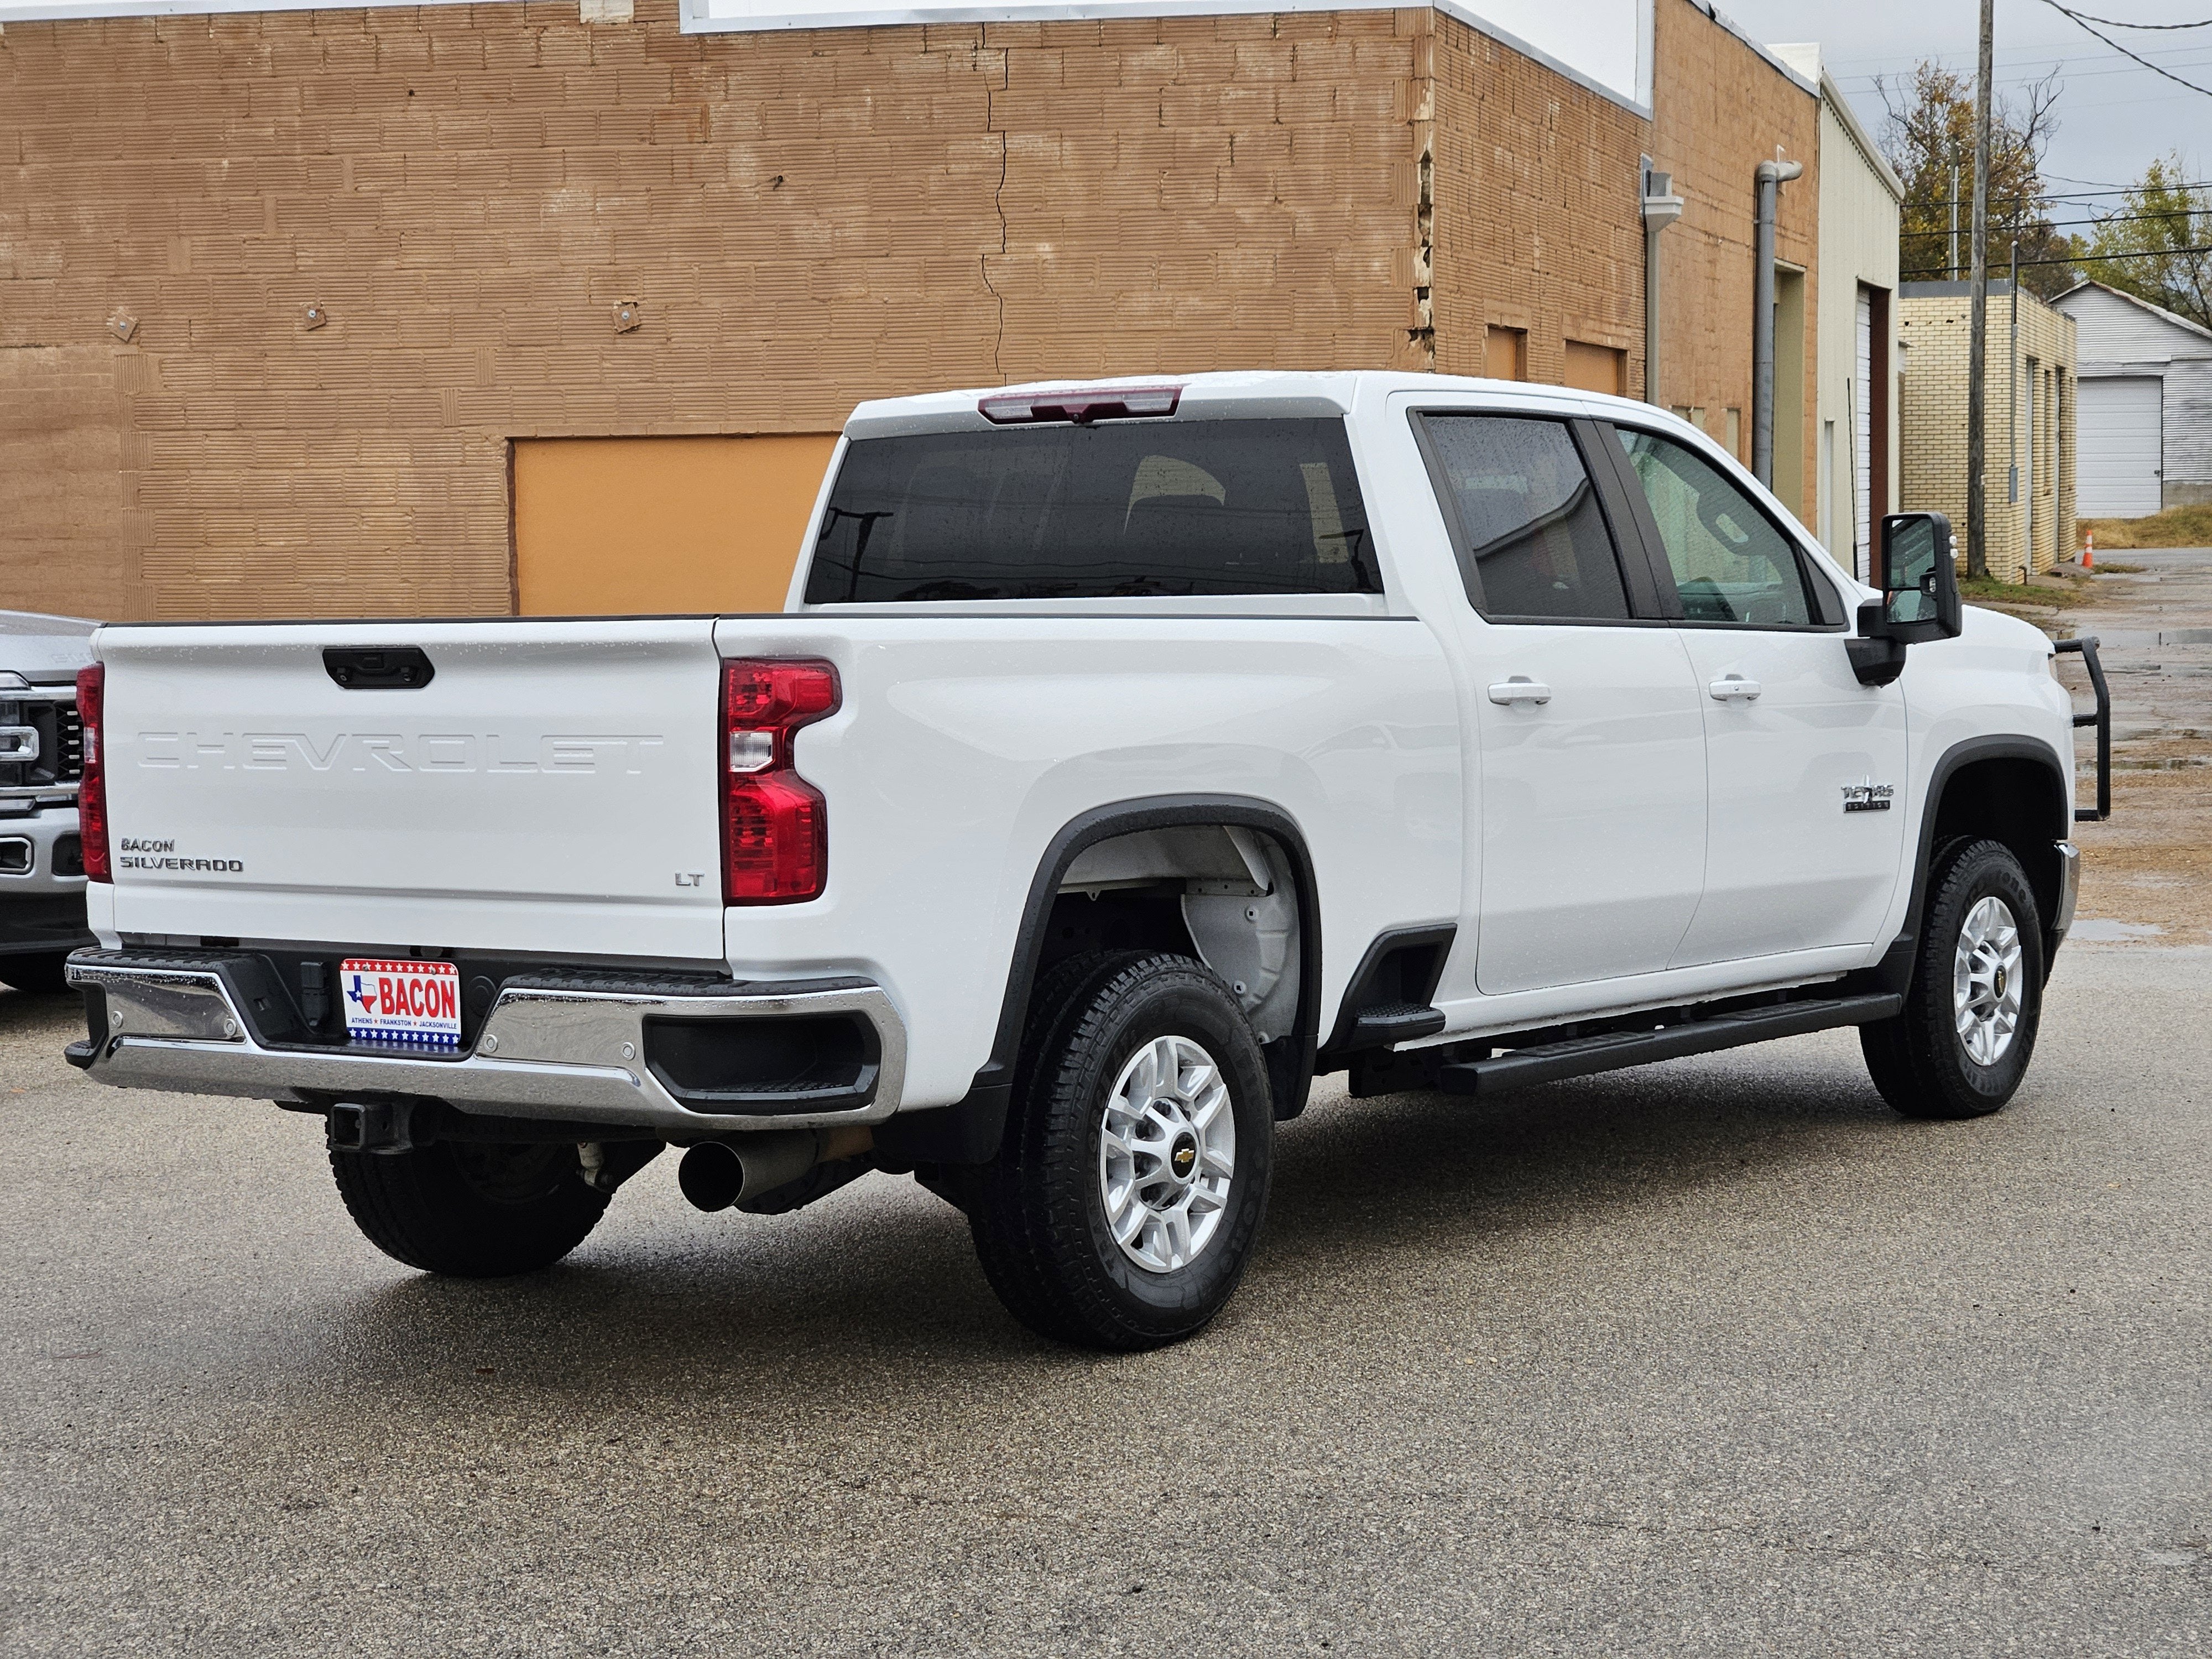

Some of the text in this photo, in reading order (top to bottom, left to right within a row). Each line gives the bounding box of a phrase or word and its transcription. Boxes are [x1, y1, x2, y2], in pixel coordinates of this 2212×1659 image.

[137, 732, 663, 774] CHEVROLET
[121, 837, 175, 852] BACON
[120, 857, 244, 872] SILVERADO
[675, 872, 705, 886] LT
[378, 977, 456, 1019] BACON
[419, 1021, 457, 1029] JACKSONVILLE
